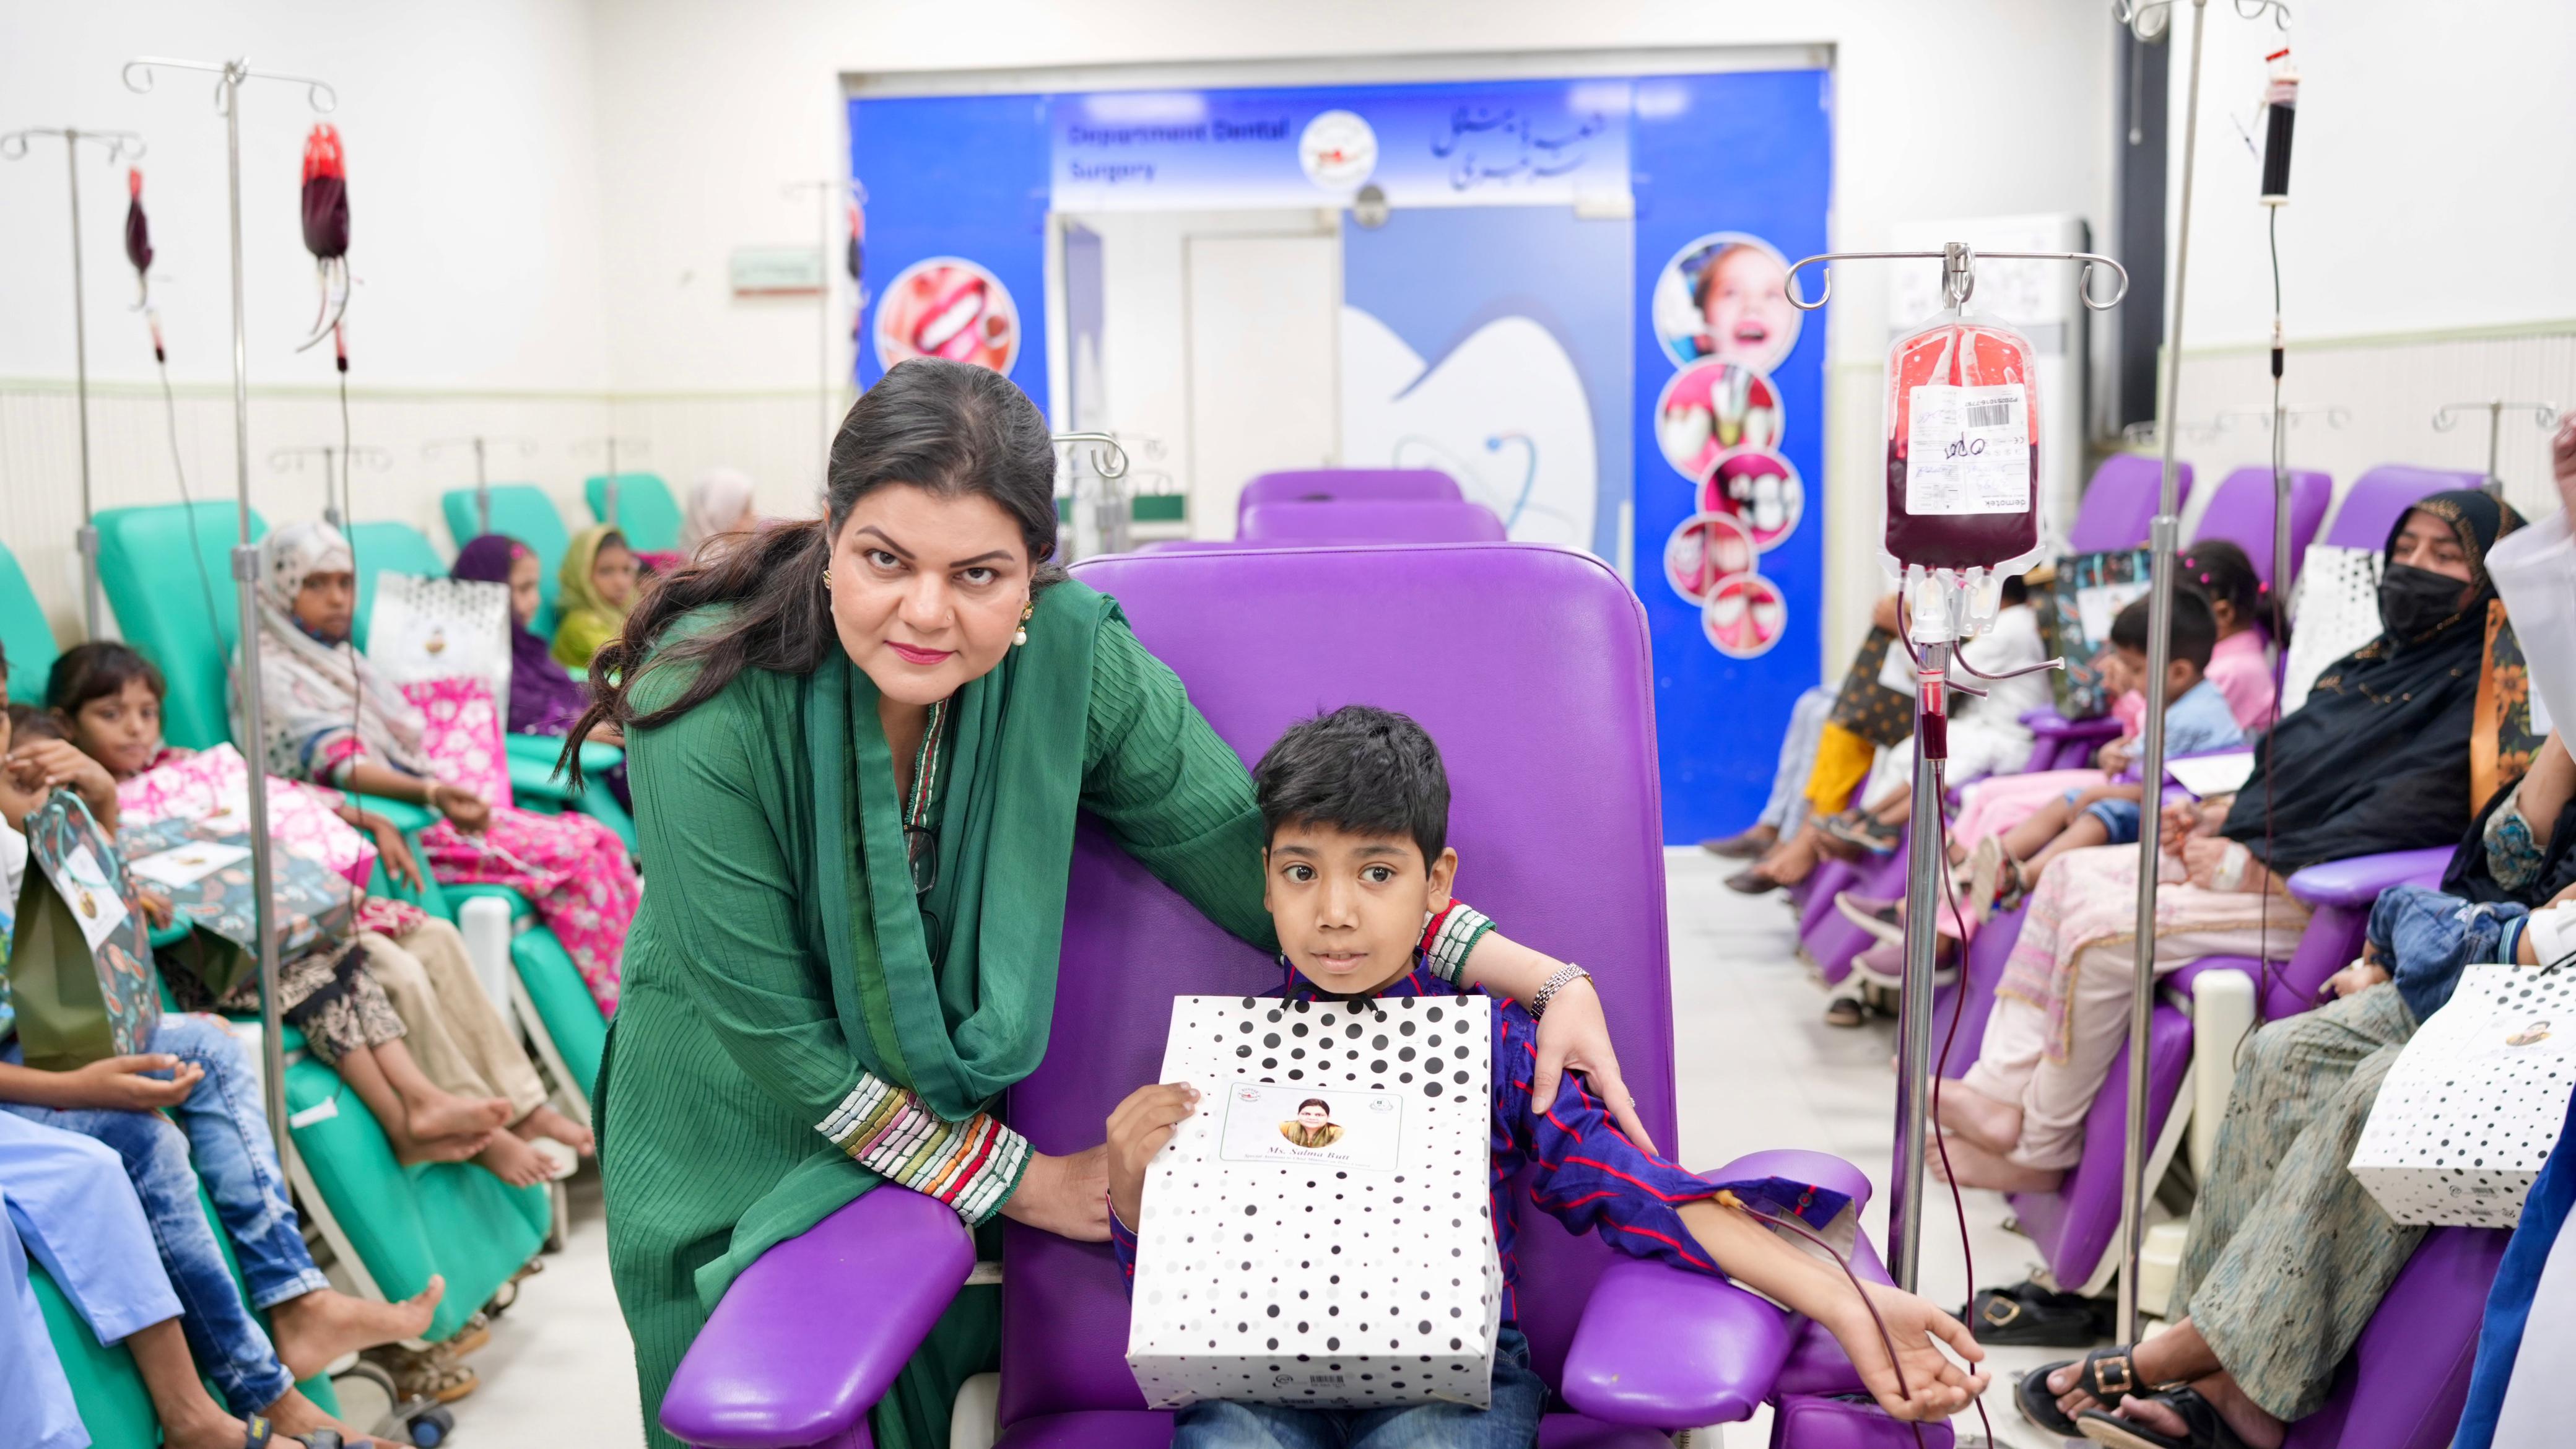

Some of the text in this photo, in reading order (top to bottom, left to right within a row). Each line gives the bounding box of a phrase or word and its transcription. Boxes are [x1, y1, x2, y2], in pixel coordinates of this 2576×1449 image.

[1069, 116, 1290, 147] Department Dental
[1071, 160, 1156, 185] Surgery
[1985, 499, 2026, 508] demotek
[1267, 1146, 1351, 1160] Ms. Salma Butt
